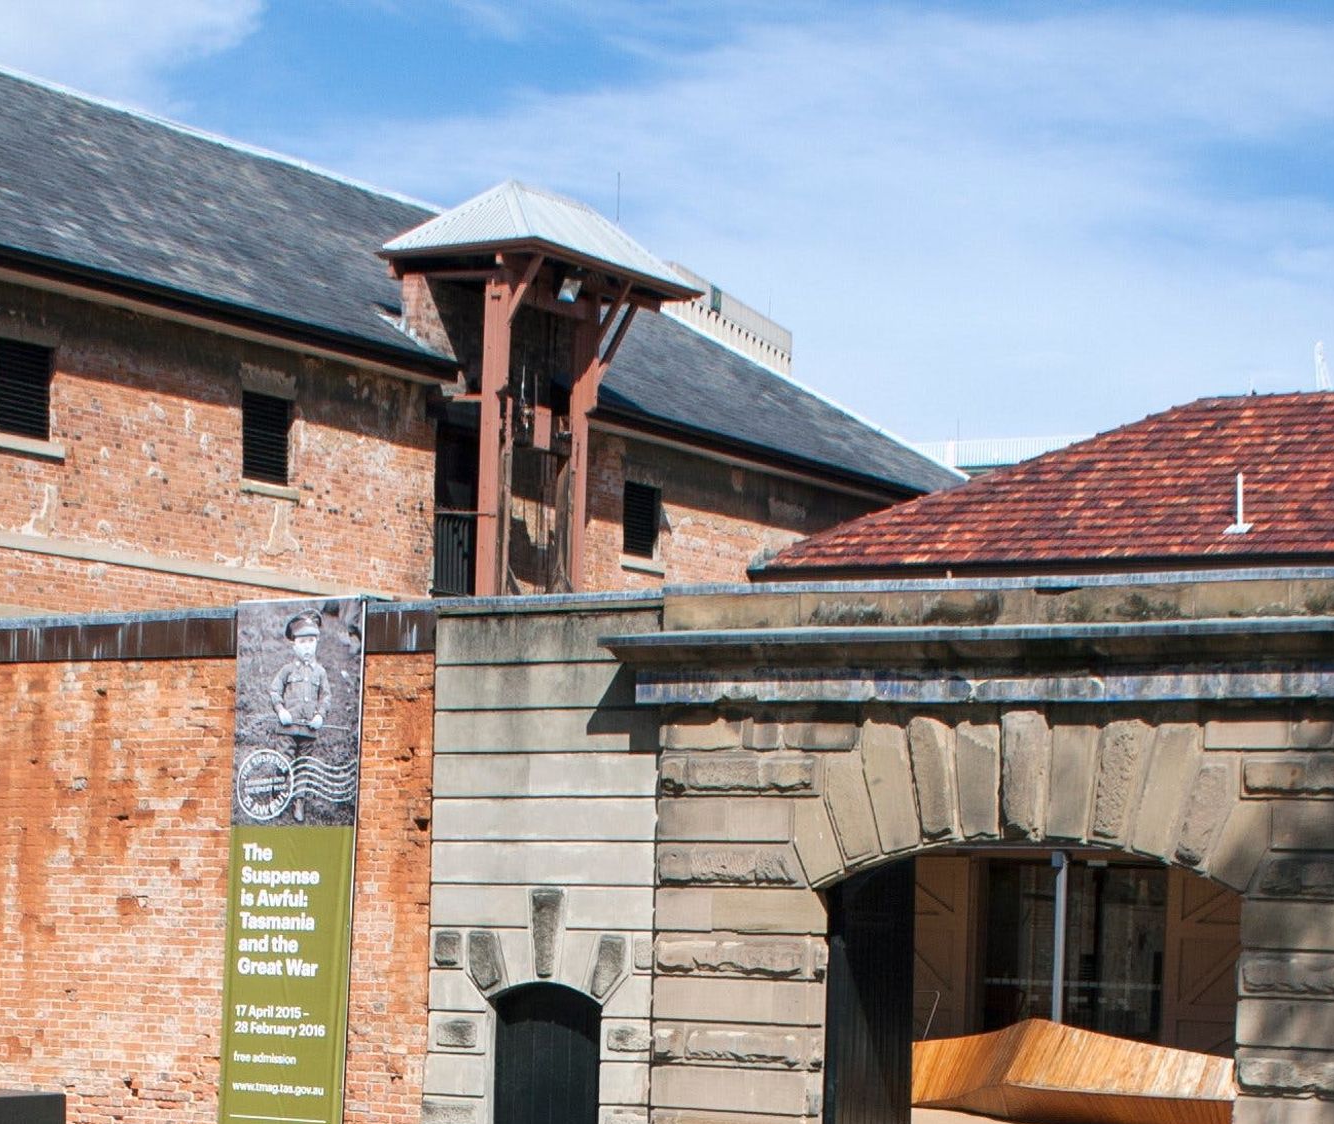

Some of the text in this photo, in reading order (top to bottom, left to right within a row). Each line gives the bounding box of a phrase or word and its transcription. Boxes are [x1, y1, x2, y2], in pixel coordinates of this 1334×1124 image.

[242, 842, 273, 861] The
[241, 866, 320, 888] Suspense
[240, 888, 308, 907] is Awful:
[239, 911, 315, 931] Tasmania
[238, 934, 299, 953] and the
[237, 956, 319, 977] Great War
[235, 1004, 247, 1017] 17
[248, 1004, 274, 1019] April
[275, 1006, 301, 1019] 2015
[234, 1021, 326, 1038] 28 February 2016
[233, 1050, 297, 1065] free admission
[232, 1082, 324, 1096] www.tmag.tas.gov.au
